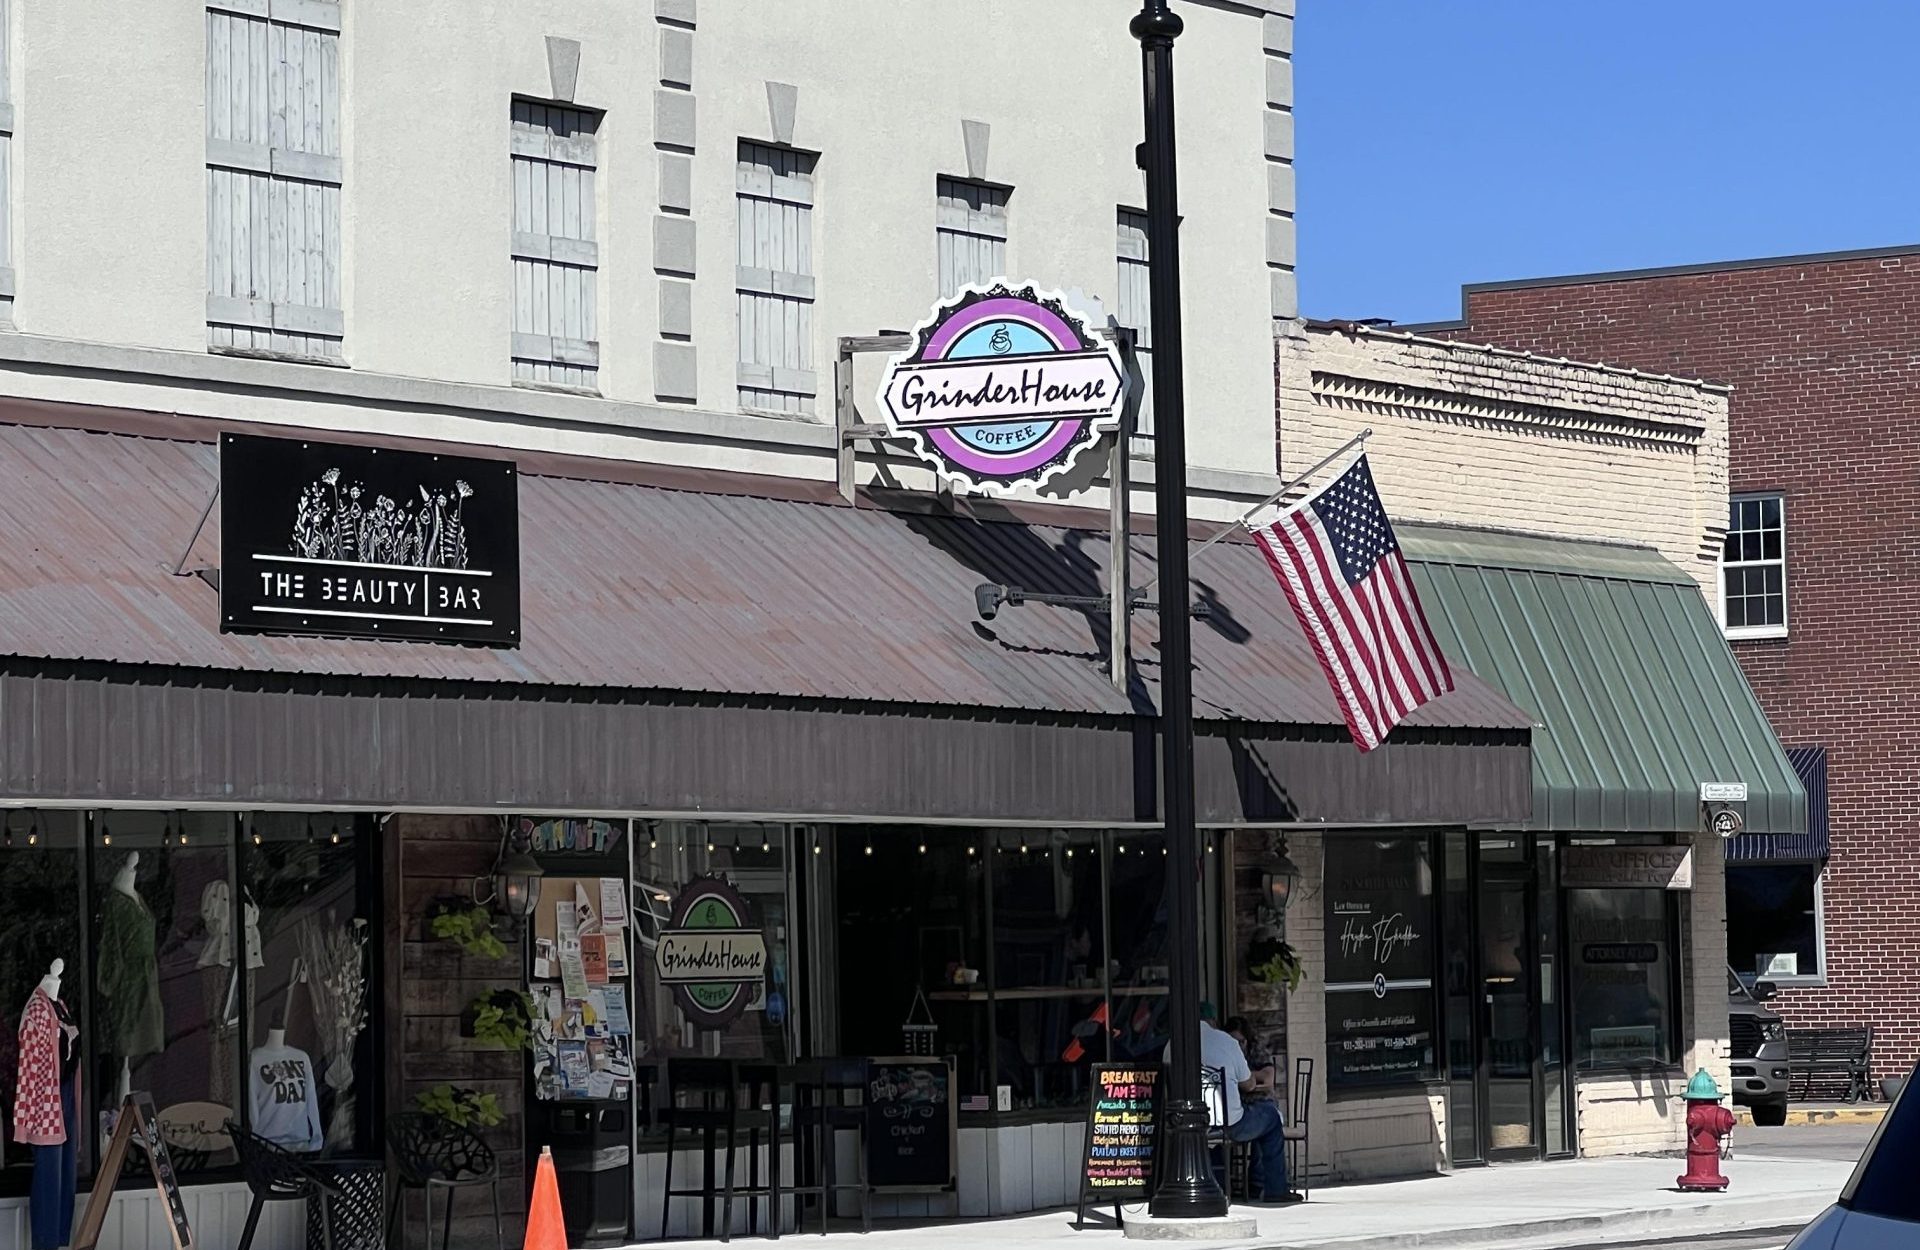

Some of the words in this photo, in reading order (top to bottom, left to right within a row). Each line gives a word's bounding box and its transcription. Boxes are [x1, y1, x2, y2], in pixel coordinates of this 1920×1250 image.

[901, 368, 1106, 416] GrinderHouse
[975, 425, 1036, 445] COFFEE
[260, 572, 304, 598] THE
[322, 577, 416, 606] BEAUTY
[439, 586, 481, 610] BAR
[662, 939, 761, 974] GrinderHouse
[698, 988, 729, 1001] COFFEE
[1100, 1071, 1158, 1085] BREAKFAST
